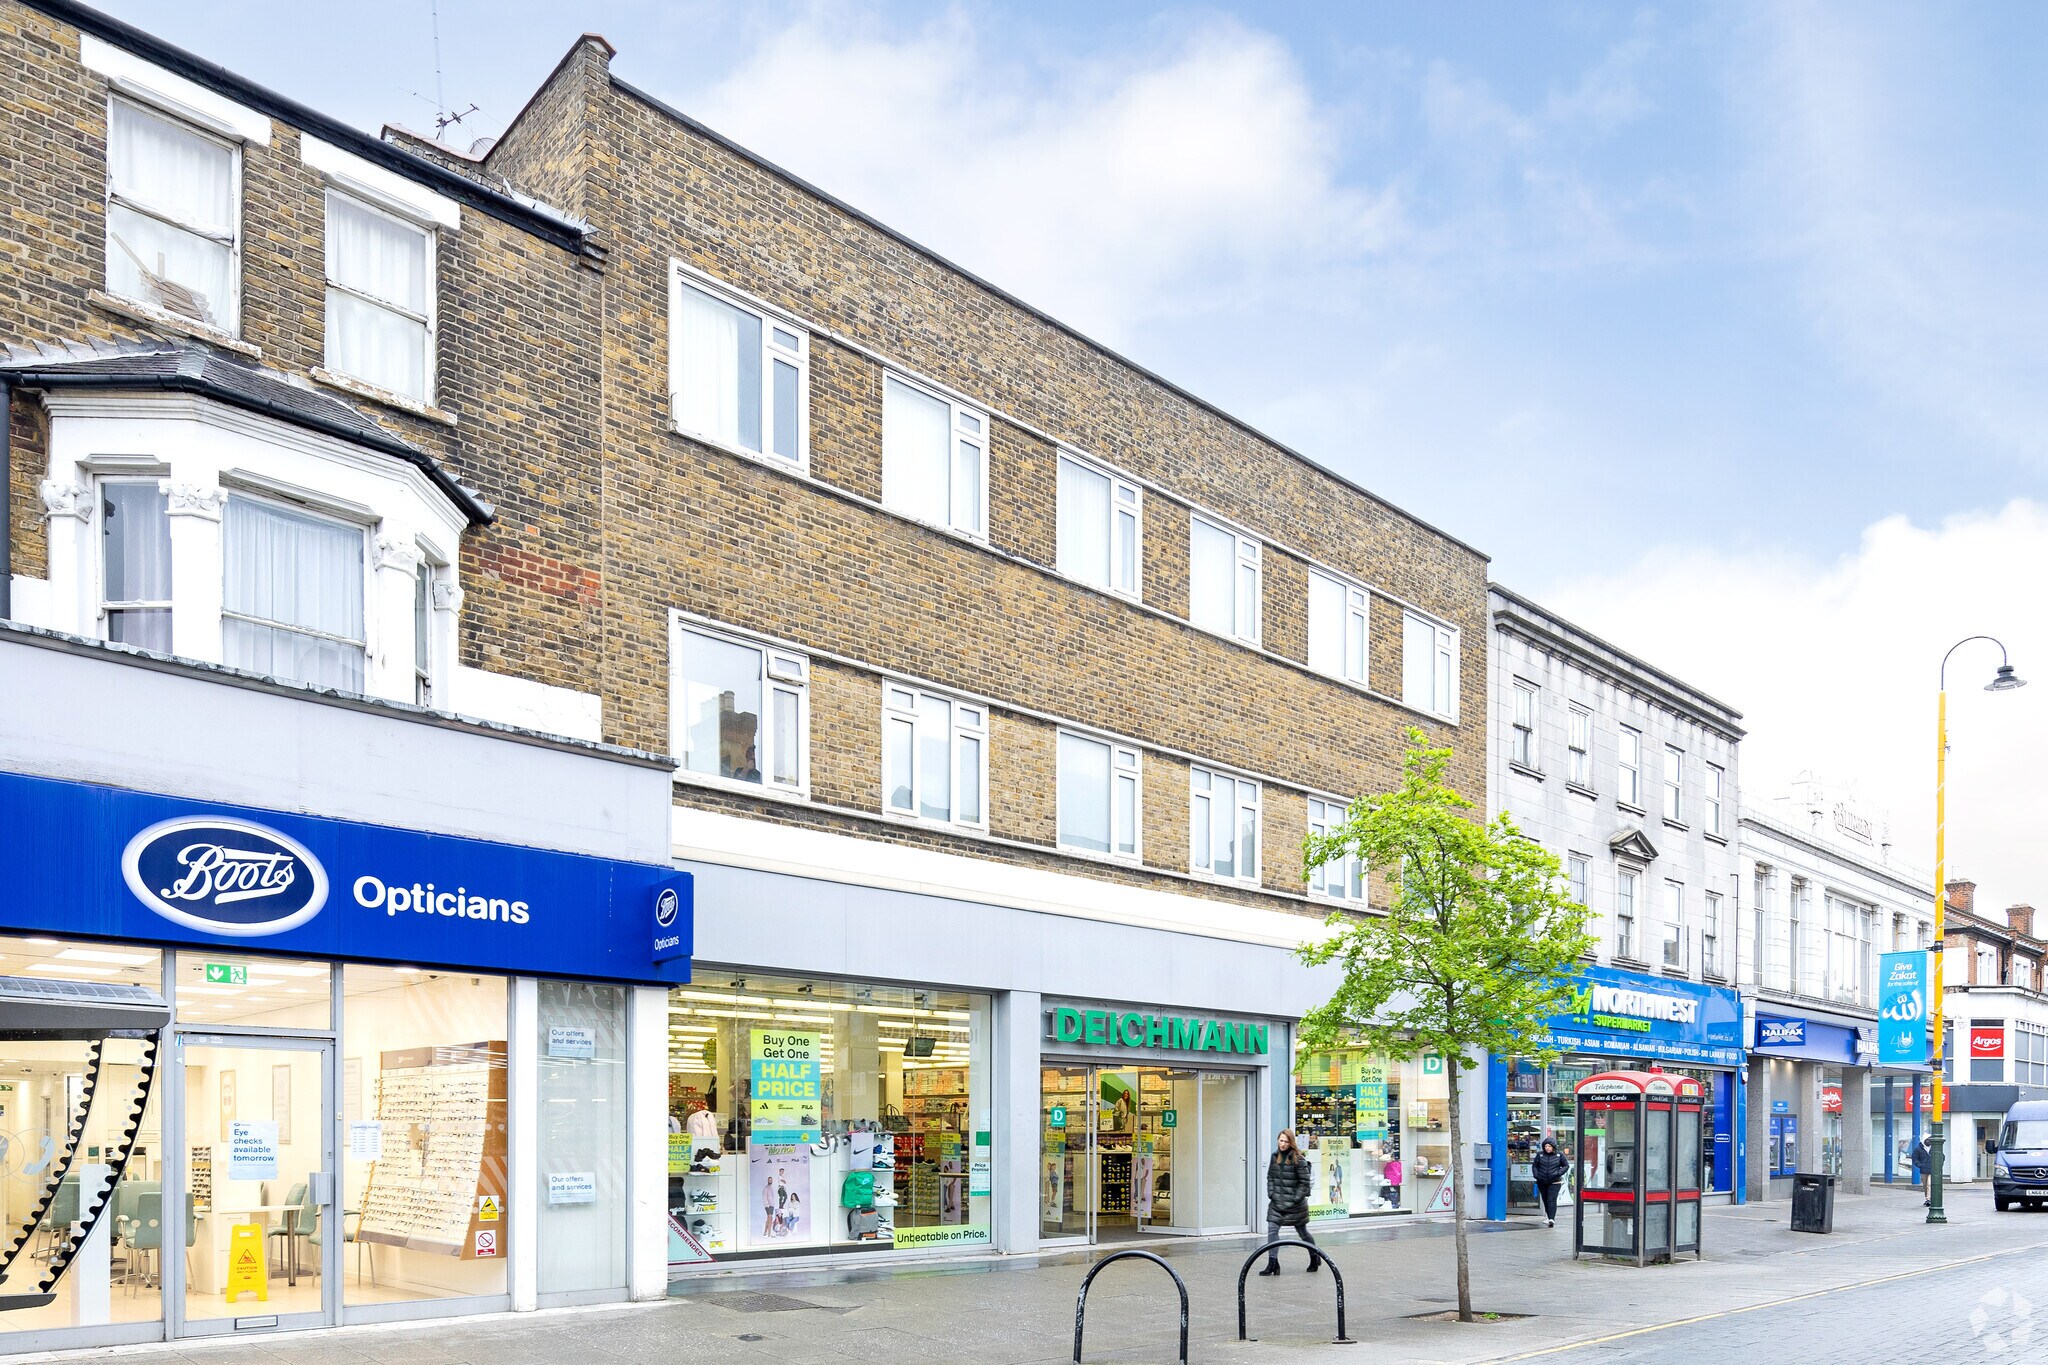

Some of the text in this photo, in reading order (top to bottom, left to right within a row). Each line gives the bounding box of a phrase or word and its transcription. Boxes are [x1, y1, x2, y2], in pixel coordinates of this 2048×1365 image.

[160, 843, 295, 905] Boots
[353, 875, 530, 924] Opticians
[654, 935, 679, 951] Opticians
[1894, 963, 1912, 971] Give
[1889, 971, 1917, 981] Zakat
[1592, 985, 1698, 1024] NORTHWEST
[1593, 1014, 1652, 1033] SUPERMARKET
[1056, 1007, 1268, 1055] DEICHMANN
[1762, 1028, 1804, 1036] HALIFAX
[763, 1034, 810, 1047] Buy One
[1972, 1036, 2002, 1047] Argos
[763, 1048, 810, 1059] Get One
[1557, 1036, 1581, 1046] TURKISH
[1584, 1038, 1600, 1048] ASIAN
[1603, 1040, 1630, 1050] ROMANIAN
[1633, 1043, 1656, 1052] ALBANIAN
[1657, 1045, 1682, 1055] BULGARIAN
[1684, 1048, 1699, 1056] POLISH
[1700, 1049, 1709, 1057] SRI
[1726, 1052, 1738, 1060] FOOD
[761, 1063, 811, 1079] HALF
[1361, 1067, 1371, 1075] Buy
[1361, 1075, 1371, 1083] Get
[757, 1080, 816, 1097] PRICE
[1360, 1085, 1383, 1097] HALF
[1595, 1083, 1624, 1093] Telephone
[1358, 1097, 1385, 1109] PRICE
[1054, 1109, 1064, 1122] D
[1165, 1112, 1175, 1122] D
[1333, 1205, 1348, 1213] Price.
[668, 1219, 703, 1257] ECOMMENDED
[897, 1229, 987, 1243] Unbeatable on Price.
